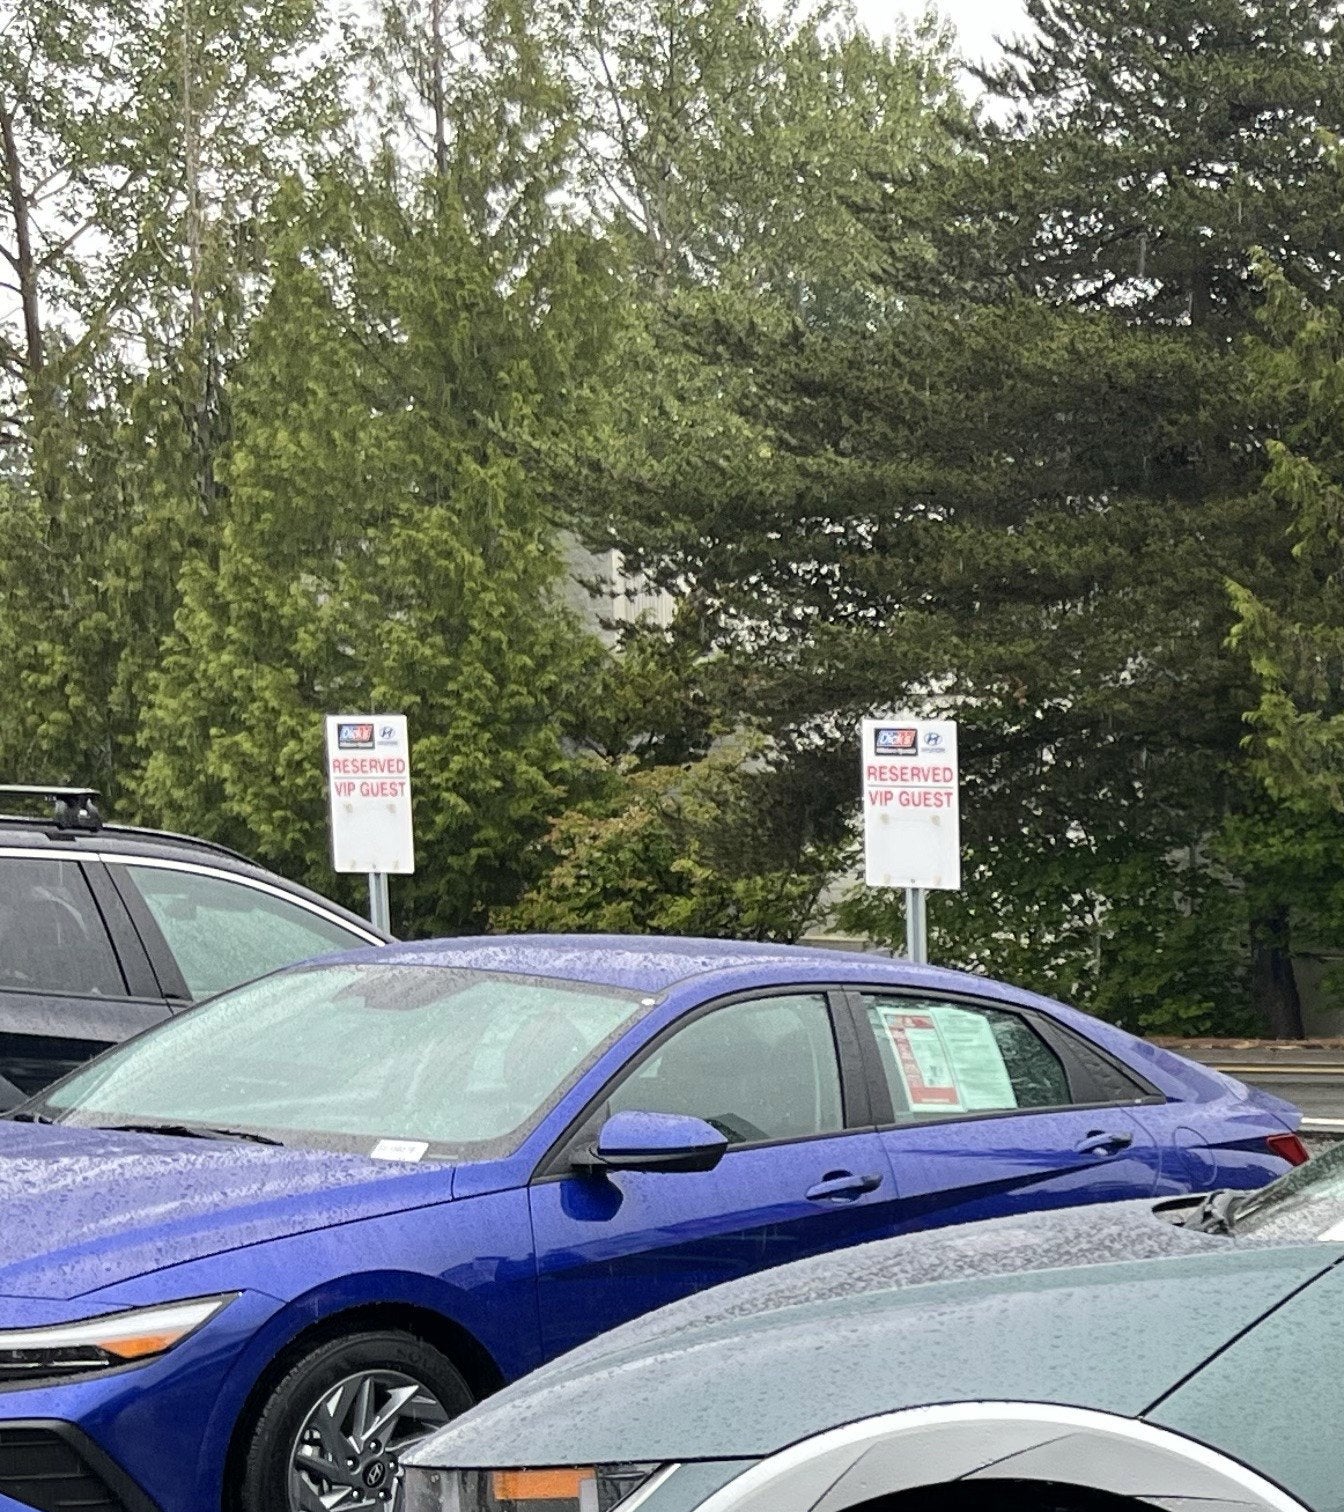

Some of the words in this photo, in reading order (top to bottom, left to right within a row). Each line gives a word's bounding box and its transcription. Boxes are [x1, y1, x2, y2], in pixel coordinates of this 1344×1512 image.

[332, 758, 406, 774] RESERVED
[866, 765, 954, 783] RESERVED
[334, 781, 356, 798] VIP
[360, 781, 406, 798] GUEST
[868, 790, 894, 806] VIP
[899, 790, 954, 808] GUEST
